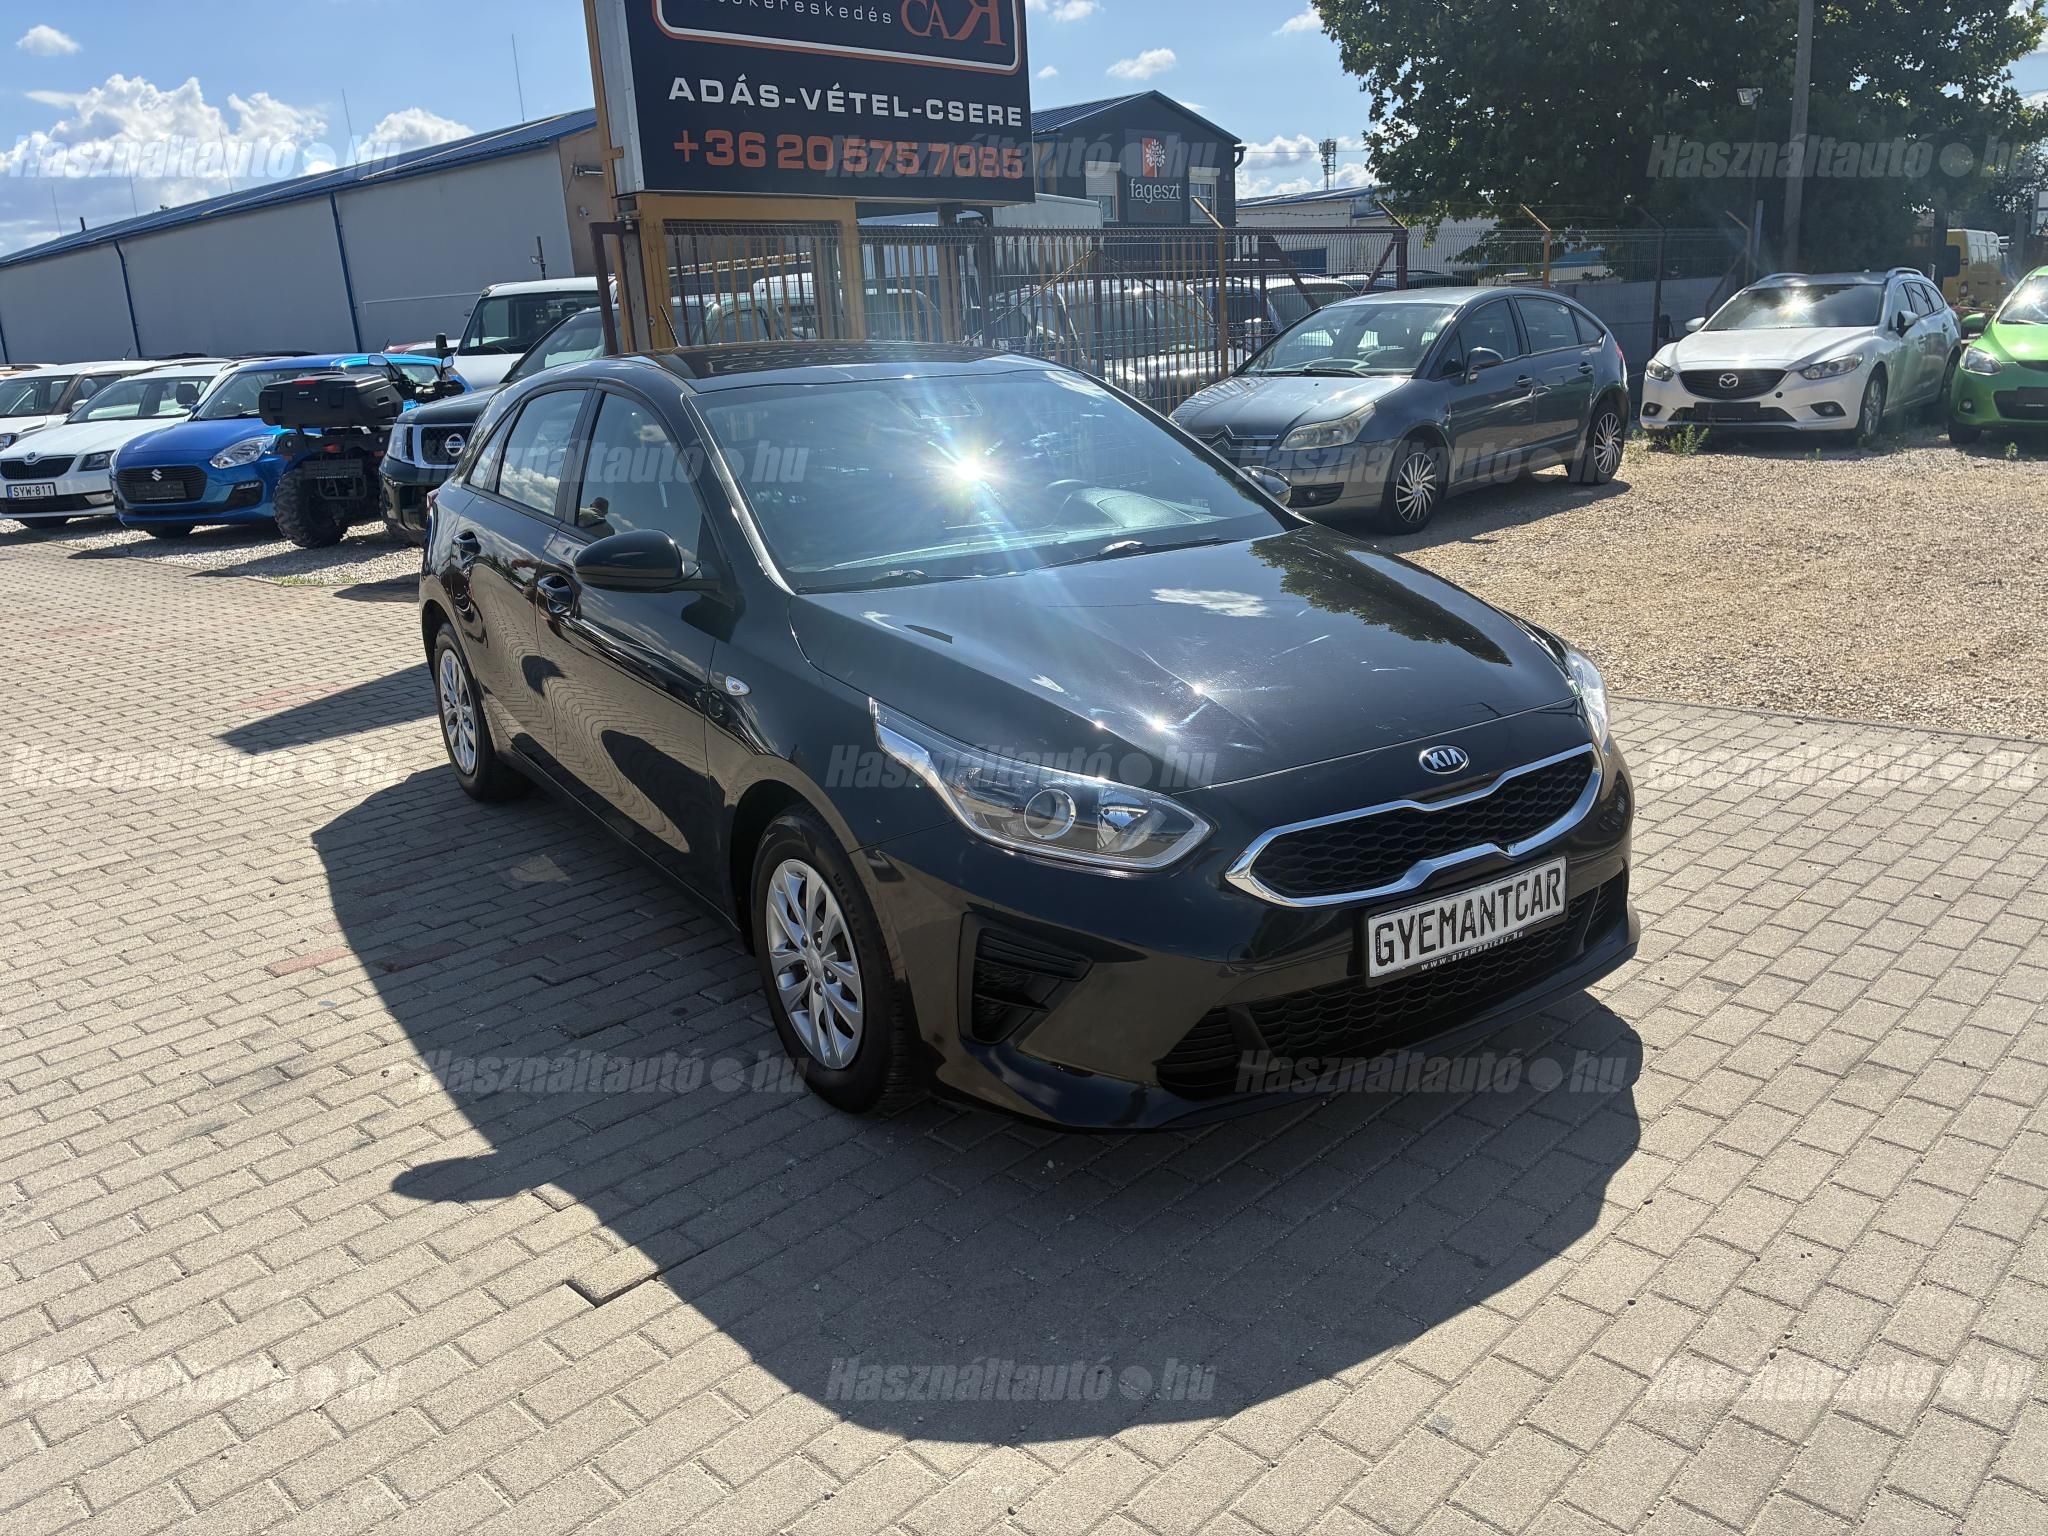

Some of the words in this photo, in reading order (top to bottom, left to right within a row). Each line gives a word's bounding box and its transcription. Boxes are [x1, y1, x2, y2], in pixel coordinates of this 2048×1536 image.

[668, 73, 1022, 127] ADÁS-VÉTEL-CSERE
[673, 129, 767, 168] +36
[776, 134, 833, 171] 20
[842, 138, 920, 175] 575
[928, 143, 1024, 179] 7085
[1130, 178, 1181, 204] fageszt
[13, 485, 52, 497] SYW-811
[1426, 748, 1464, 769] KIA
[1375, 868, 1561, 967] GYEMANTCAR
